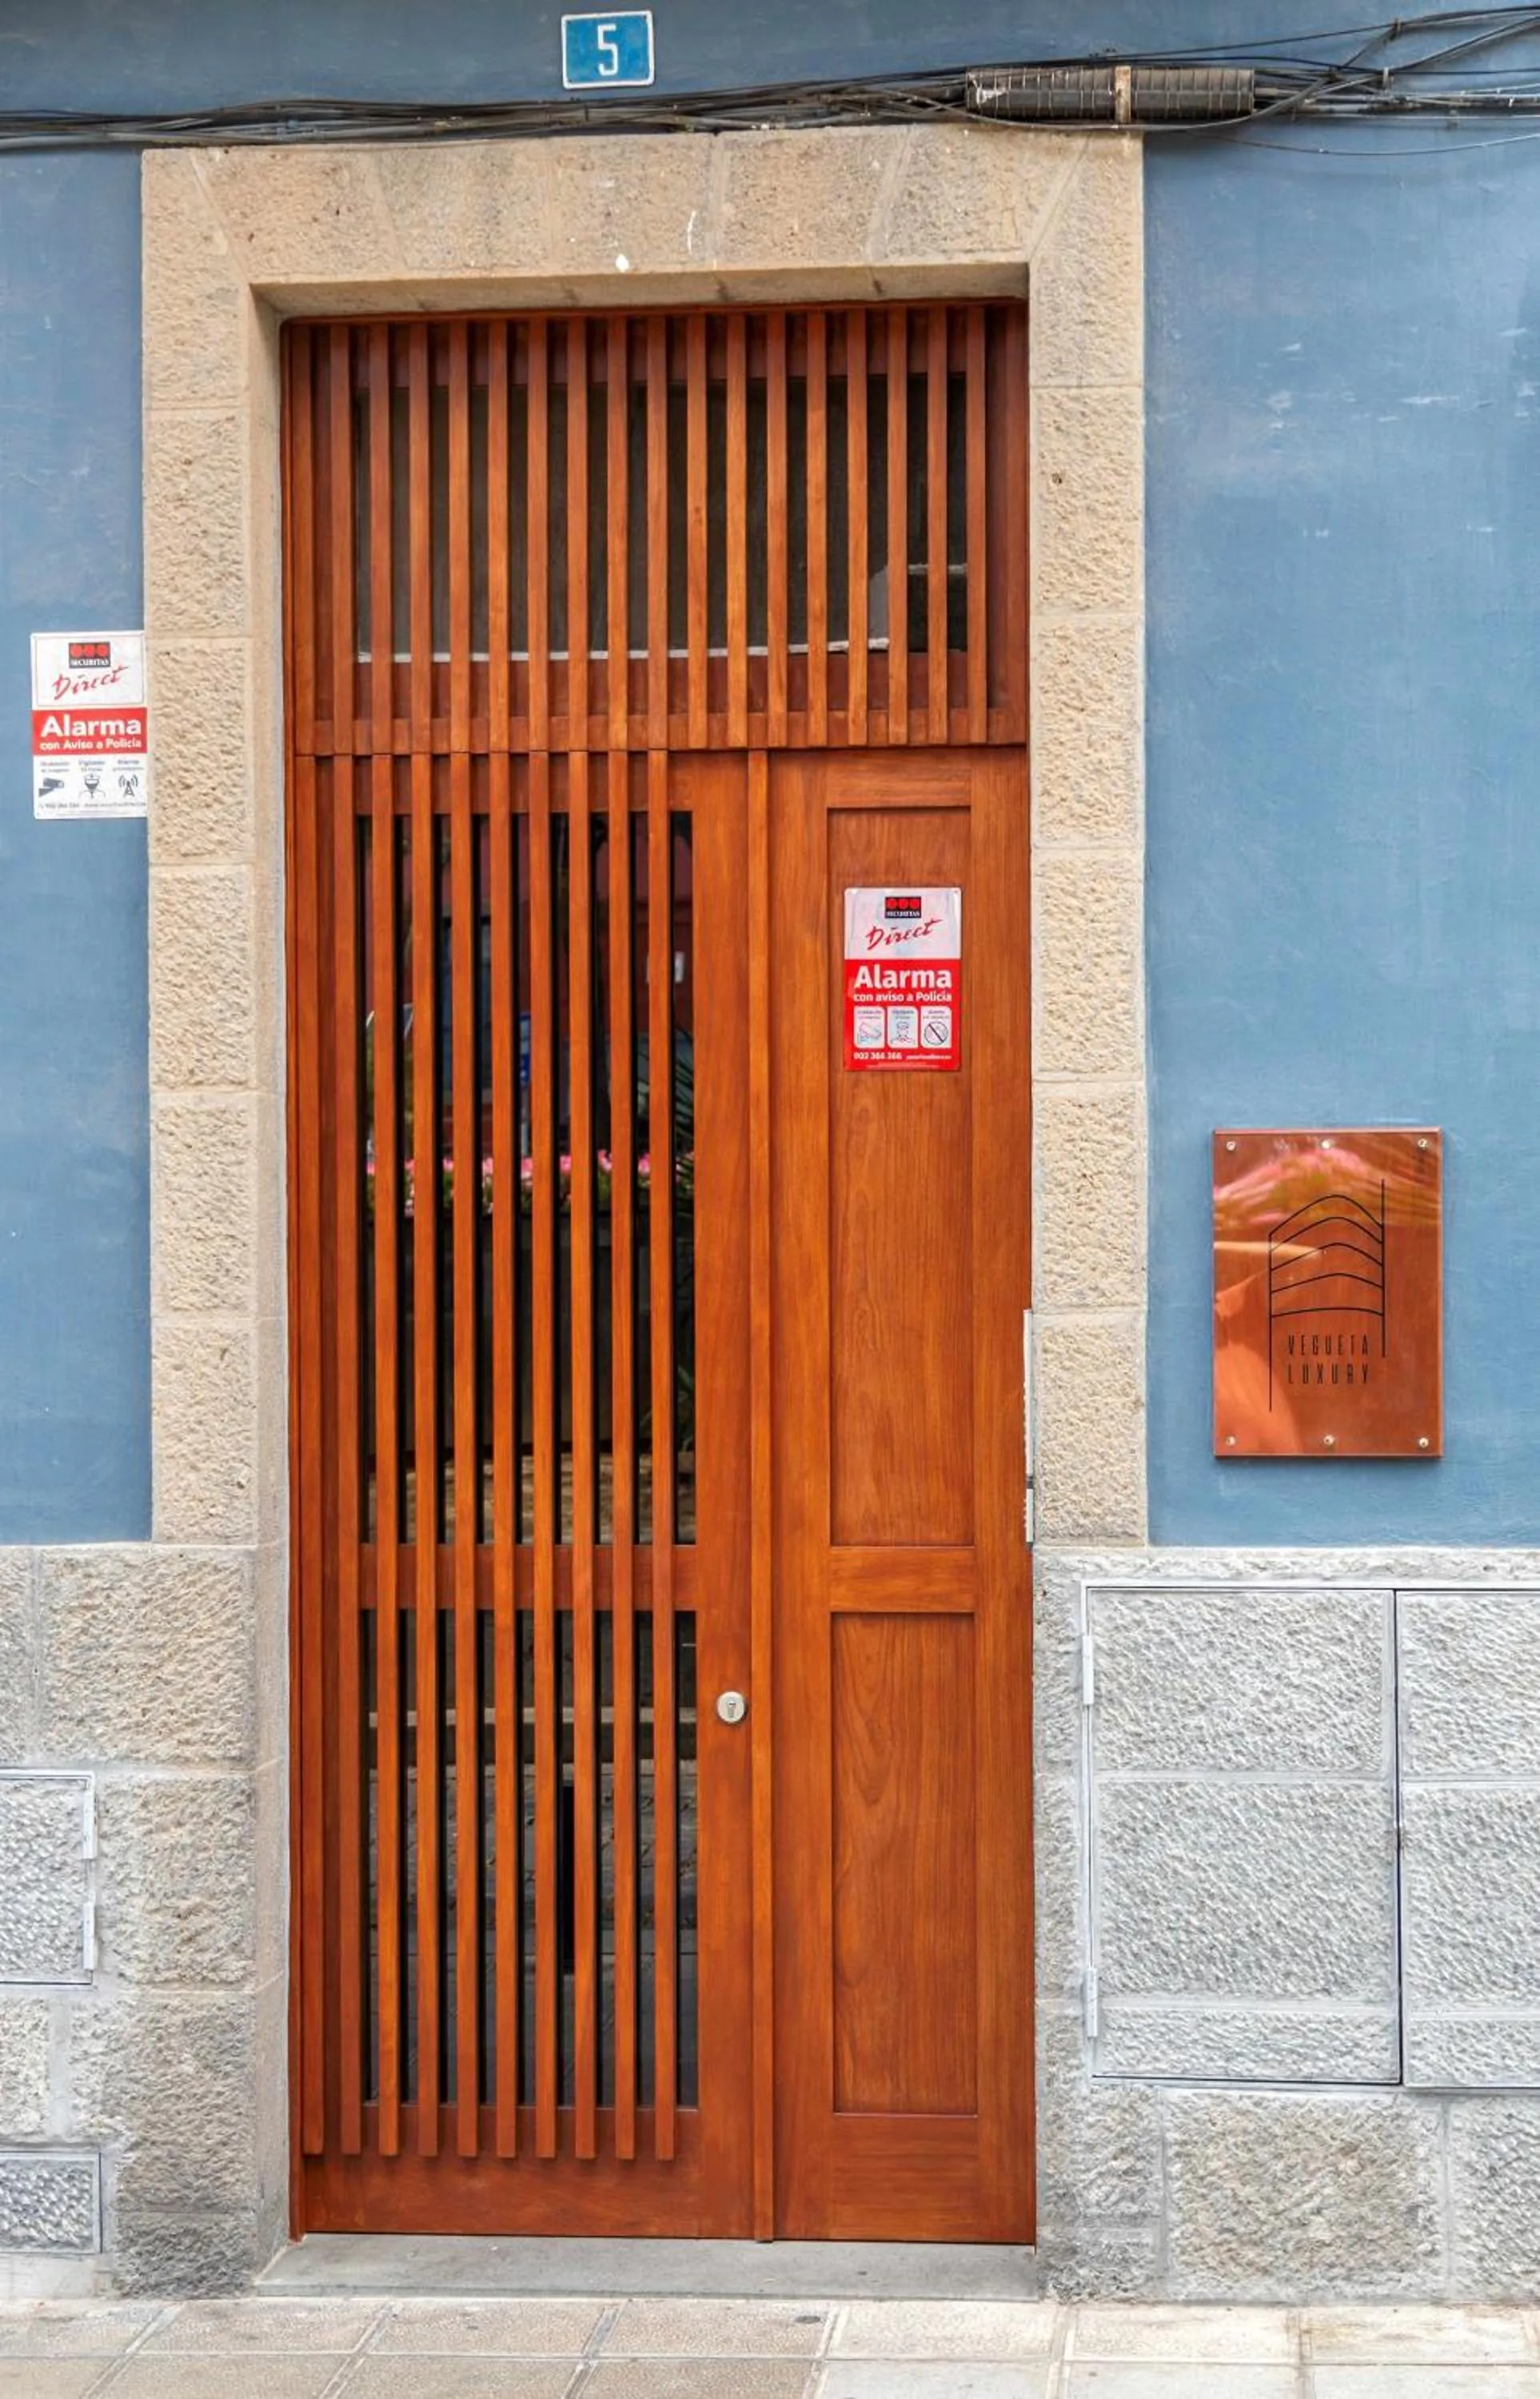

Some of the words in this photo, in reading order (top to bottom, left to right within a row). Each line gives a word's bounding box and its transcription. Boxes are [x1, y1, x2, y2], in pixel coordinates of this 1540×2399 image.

[597, 23, 618, 76] 5
[51, 665, 129, 701] Direct
[40, 714, 142, 738] Alarma
[39, 741, 60, 751] con
[63, 740, 94, 750] Aviso
[865, 918, 943, 950] Direct
[854, 964, 952, 989] Alarma
[876, 992, 904, 1002] aviso
[1287, 1335, 1368, 1355] VEGUETA
[1287, 1363, 1368, 1384] LUXURY
